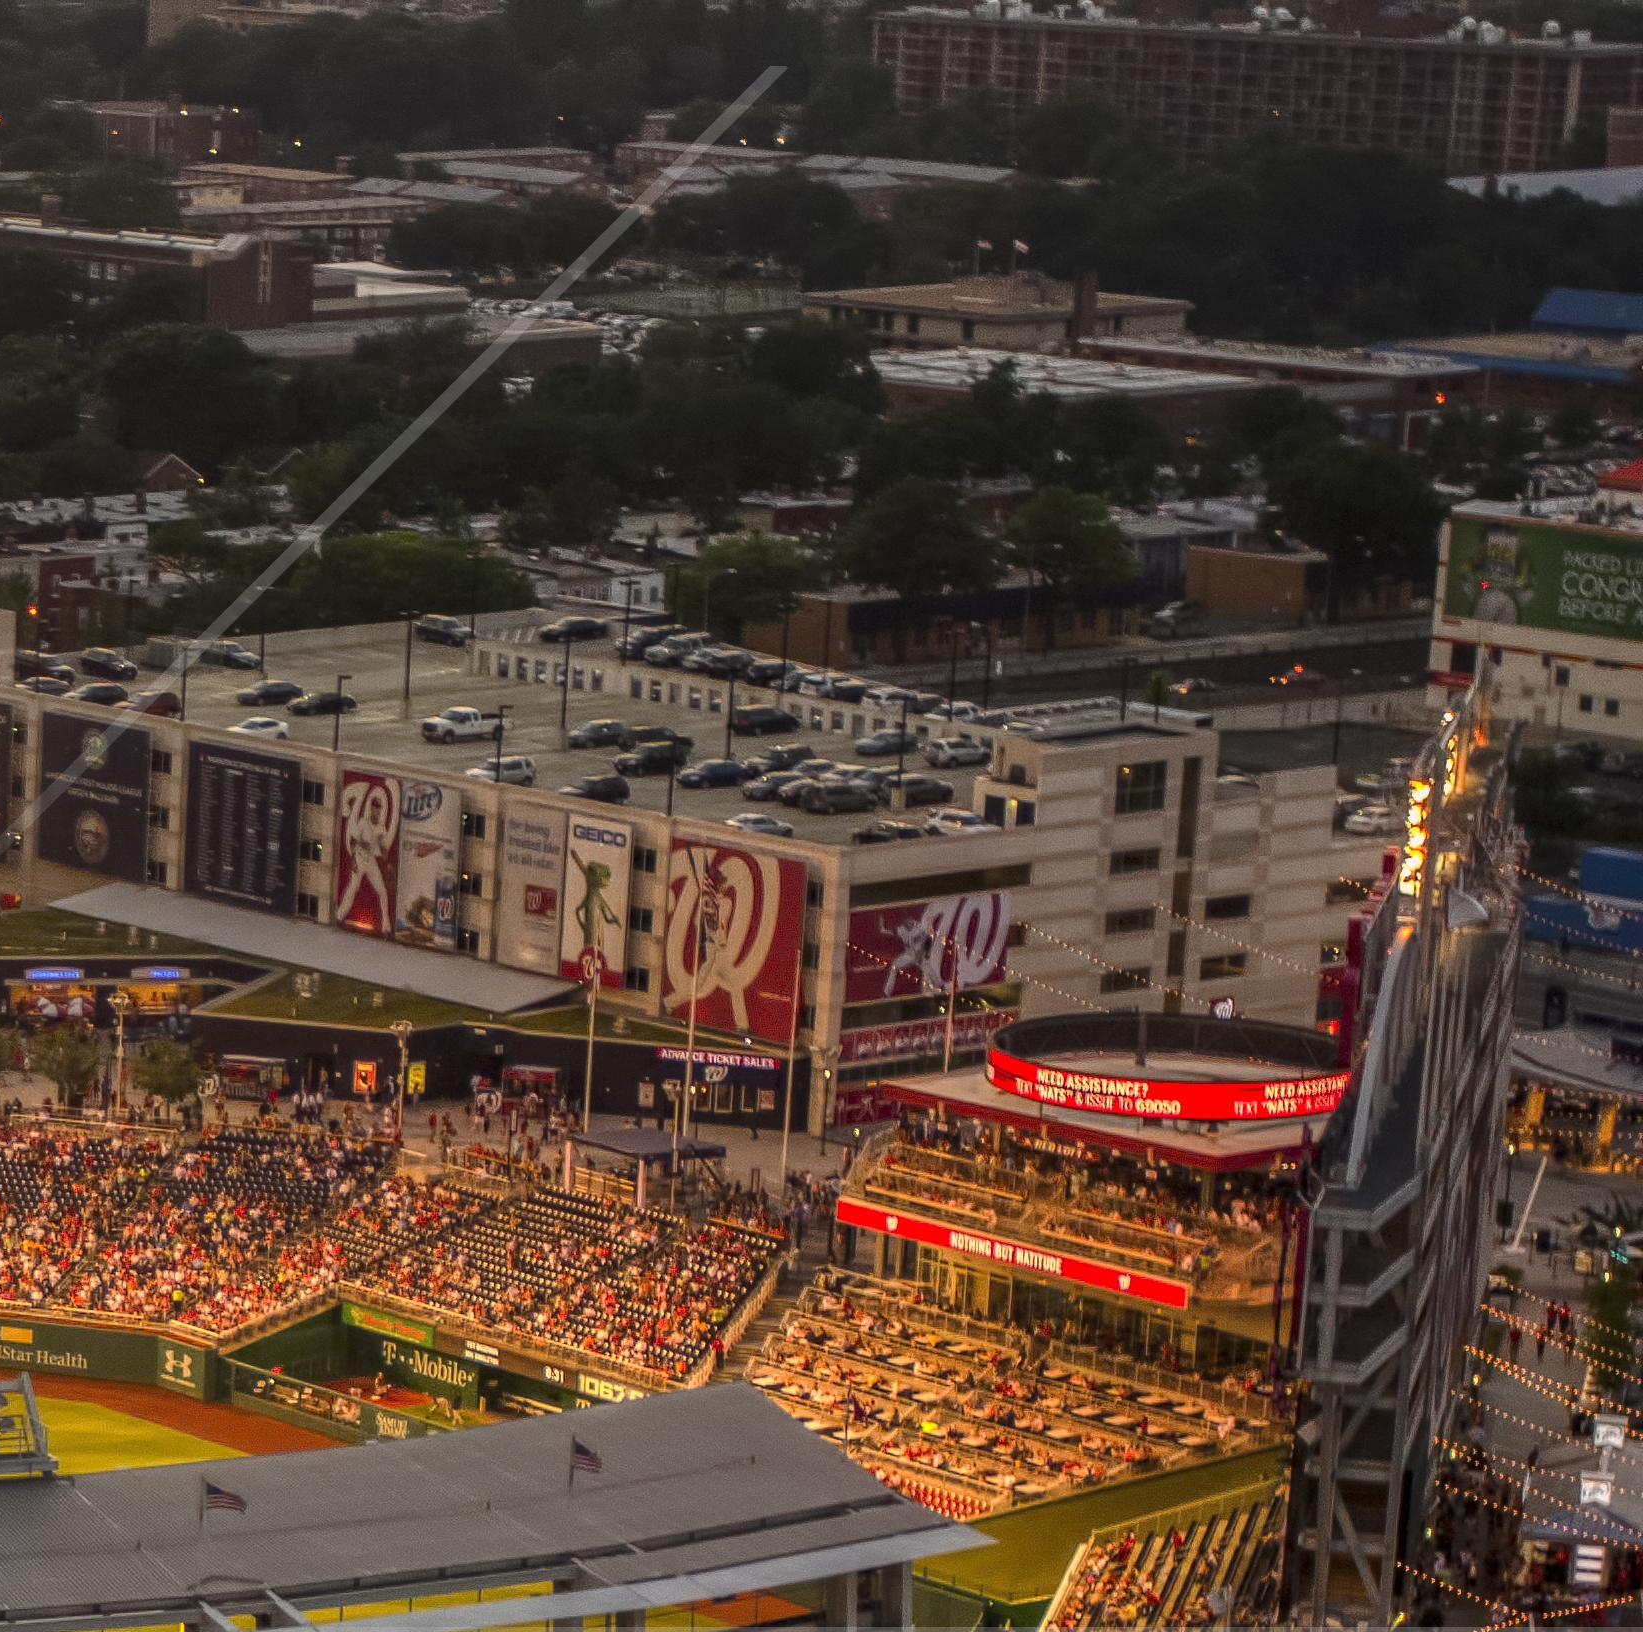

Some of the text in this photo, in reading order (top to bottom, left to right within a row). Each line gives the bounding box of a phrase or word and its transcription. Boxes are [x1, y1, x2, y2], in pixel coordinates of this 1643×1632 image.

[1558, 597, 1627, 624] BEFORE
[573, 824, 627, 847] GEICO
[707, 1052, 741, 1066] TICKET
[743, 1056, 774, 1068] SALES
[1037, 1068, 1148, 1097] NEED ASSISTANCE?
[1264, 1083, 1296, 1100] NEED
[1119, 1096, 1133, 1111] TO
[1135, 1099, 1181, 1115] 69050
[949, 1231, 1063, 1275] NOTHING BUT NATITUDE
[37, 1350, 89, 1369] Health
[376, 1411, 407, 1430] SAMUEL
